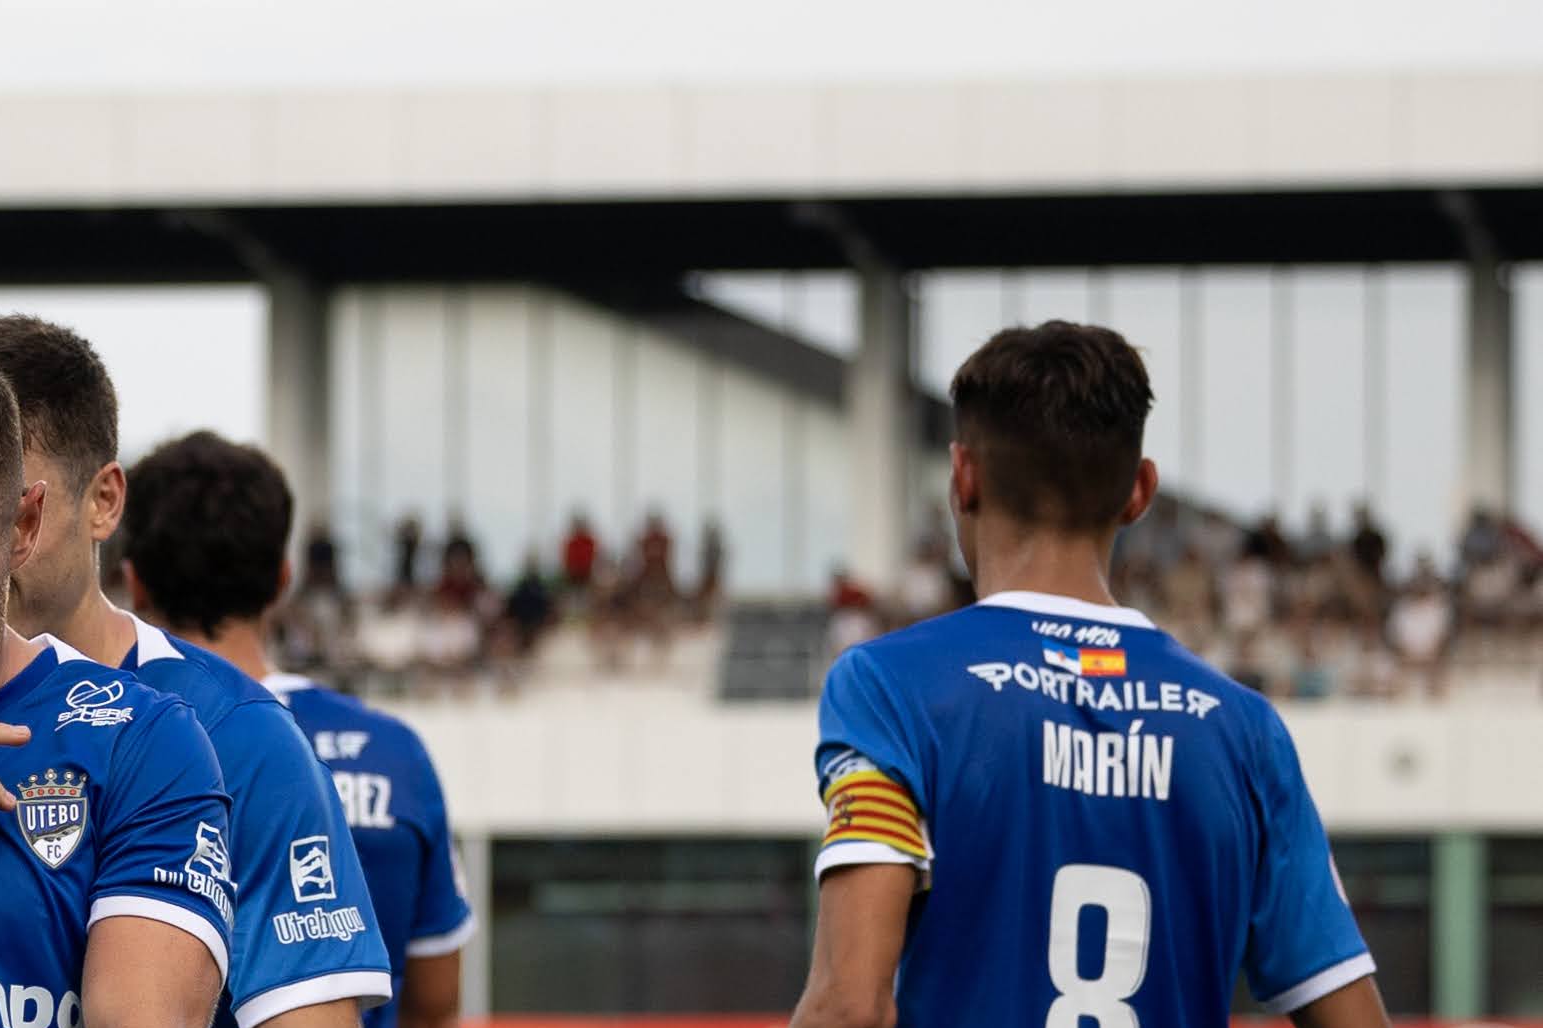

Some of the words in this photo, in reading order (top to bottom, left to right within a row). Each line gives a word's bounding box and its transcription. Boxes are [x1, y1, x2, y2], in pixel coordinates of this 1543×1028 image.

[967, 662, 1220, 719] PORTRAILER
[1043, 719, 1174, 801] MARÍN
[26, 803, 80, 831] UTEBO
[46, 844, 62, 859] FC
